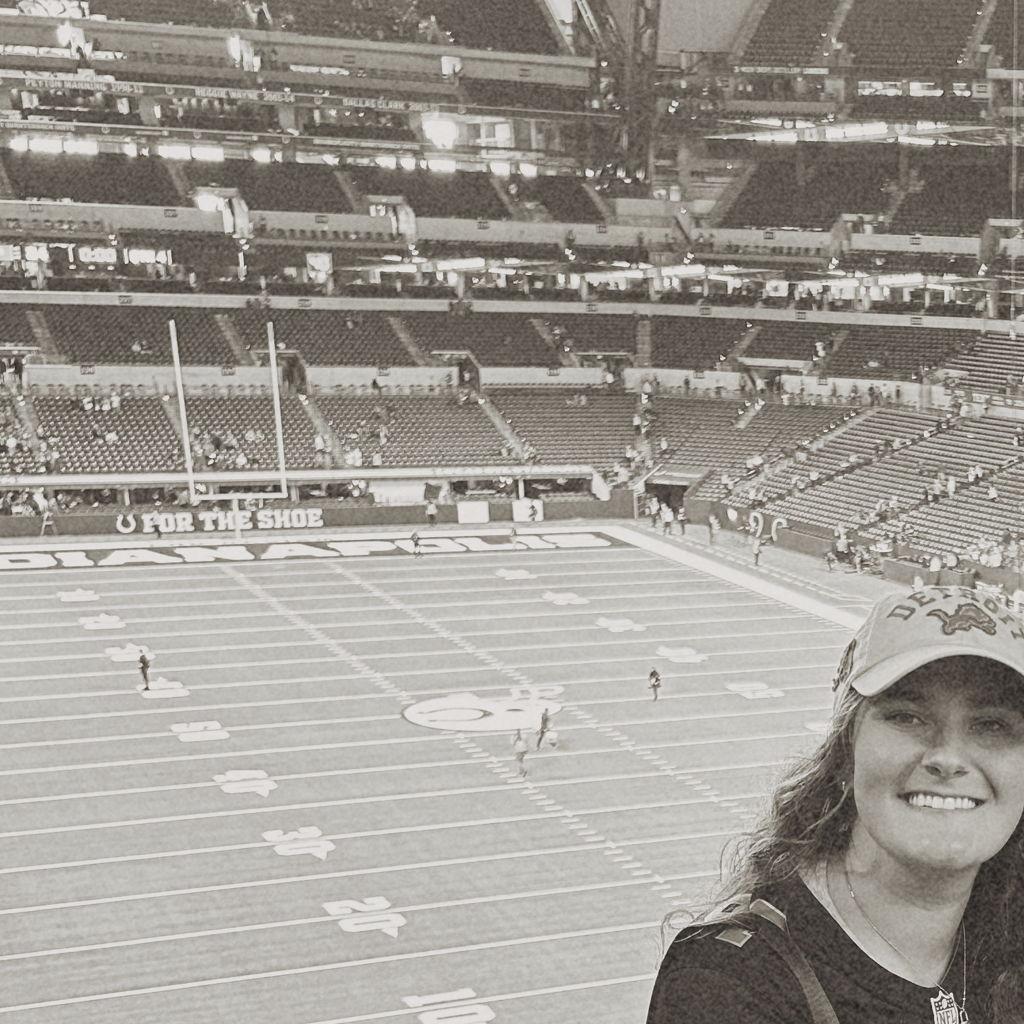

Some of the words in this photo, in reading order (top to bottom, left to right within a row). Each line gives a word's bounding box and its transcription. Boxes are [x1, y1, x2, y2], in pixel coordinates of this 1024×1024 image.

[141, 511, 194, 533] FOR
[199, 509, 253, 531] THE
[257, 508, 324, 529] SHOE
[262, 826, 336, 857] 30
[322, 896, 407, 933] 20
